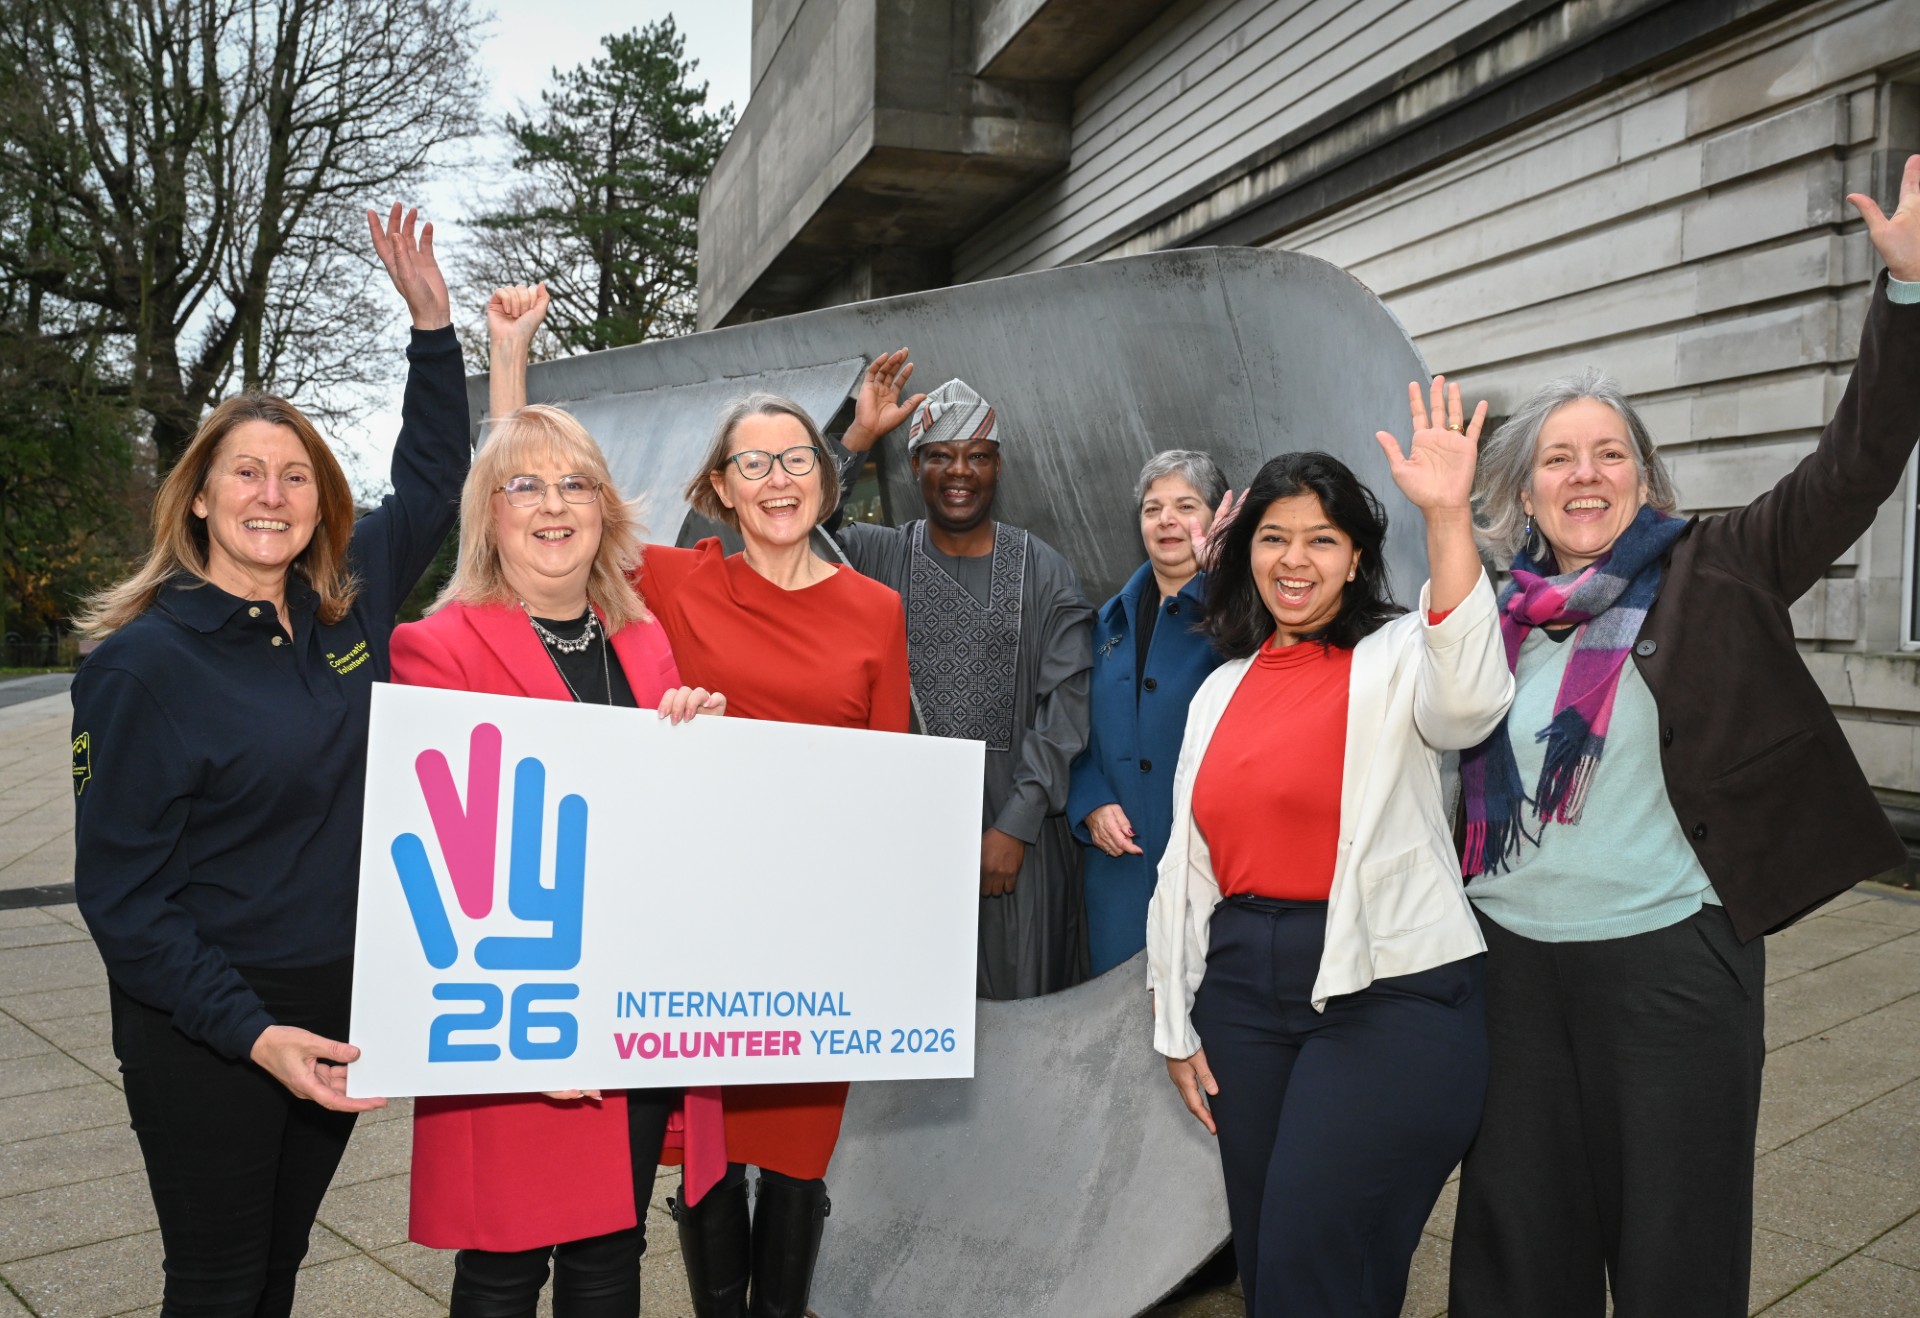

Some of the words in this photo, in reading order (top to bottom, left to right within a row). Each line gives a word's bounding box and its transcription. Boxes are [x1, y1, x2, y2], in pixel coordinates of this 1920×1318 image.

[616, 990, 852, 1019] INTERNATIONAL
[428, 982, 580, 1064] 26
[613, 1030, 803, 1060] VOLUNTEER
[810, 1028, 883, 1056] YEAR
[890, 1027, 957, 1055] 2026
